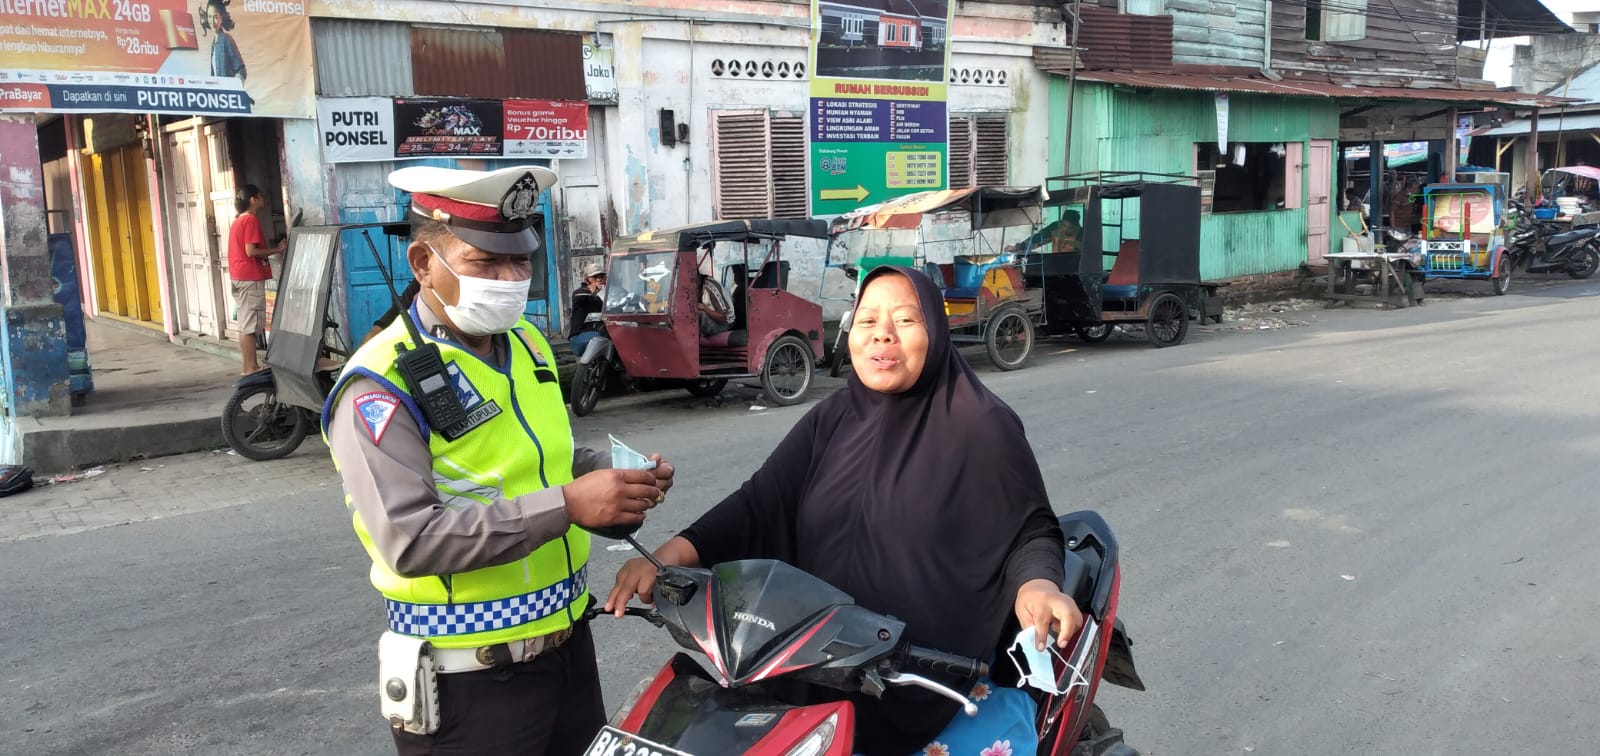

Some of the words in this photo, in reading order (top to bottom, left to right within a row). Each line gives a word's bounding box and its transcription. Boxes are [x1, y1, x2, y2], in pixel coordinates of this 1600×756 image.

[113, 0, 151, 22] 24GB
[587, 64, 610, 78] Joko
[0, 87, 42, 102] PraBayar
[63, 90, 102, 103] Dapatkan
[104, 91, 112, 102] di
[113, 91, 127, 102] sini
[835, 83, 871, 94] RUMAH
[874, 85, 929, 96] BERSUBSIDI
[137, 91, 184, 107] PUTRI
[187, 93, 246, 109] PONSEL
[332, 111, 379, 126] PUTRI
[541, 117, 568, 125] hingga
[325, 130, 387, 146] PONSEL
[507, 124, 521, 133] Rp
[524, 126, 588, 140] 70ribu
[732, 611, 776, 631] HONDA
[590, 731, 622, 756] BK
